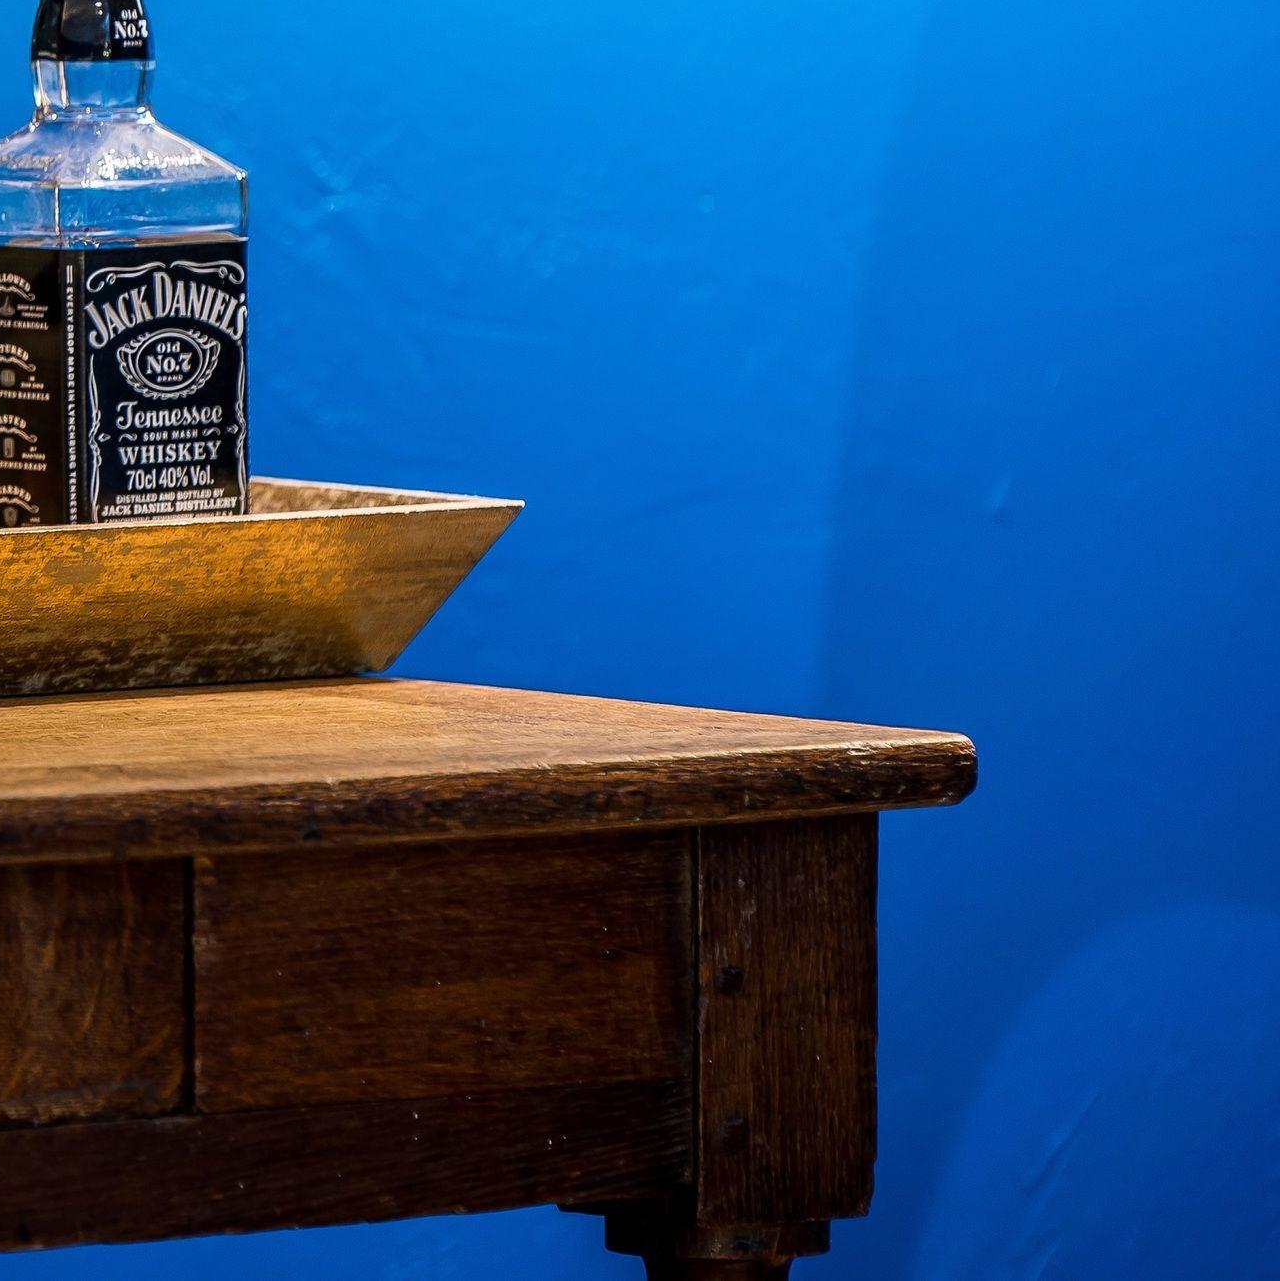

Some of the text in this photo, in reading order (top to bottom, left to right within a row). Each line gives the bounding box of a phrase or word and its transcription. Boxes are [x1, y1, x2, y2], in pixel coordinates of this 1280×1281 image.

[114, 20, 149, 40] No.7
[84, 271, 248, 349] JACK DANIEL'S
[156, 341, 181, 354] Old
[145, 352, 194, 375] No.7
[115, 400, 223, 430] Tennessee
[142, 429, 199, 442] SOUR MASH
[118, 440, 222, 466] WHISKEY
[126, 464, 215, 491] 70cl 40% Vol.
[69, 471, 78, 524] TENNESS
[101, 497, 238, 517] JACK DANIEL DISTILLERY
[116, 487, 225, 505] DISTILLED AND BOTTLED BY
